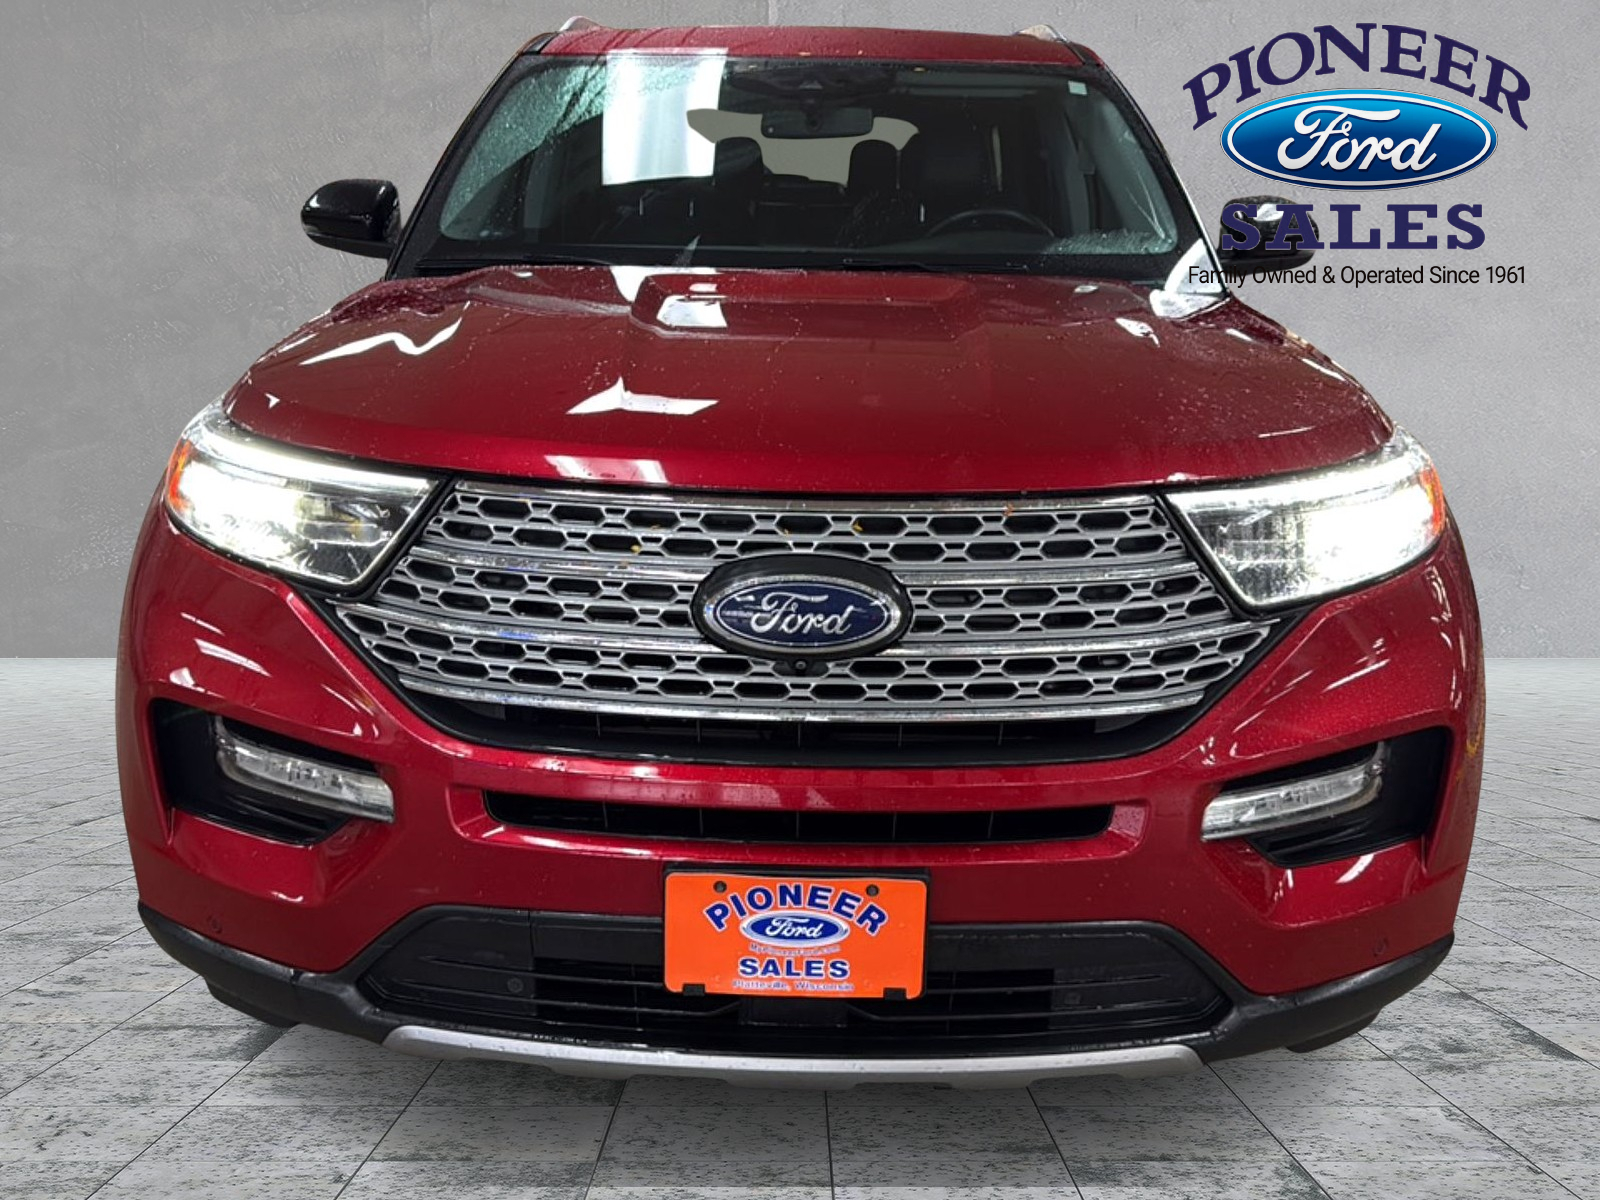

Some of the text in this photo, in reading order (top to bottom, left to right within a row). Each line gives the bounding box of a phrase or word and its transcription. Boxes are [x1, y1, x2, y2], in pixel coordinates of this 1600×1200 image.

[751, 591, 853, 634] Ford
[703, 883, 888, 935] PIONEER
[765, 917, 824, 938] Ford
[739, 957, 850, 979] SALES
